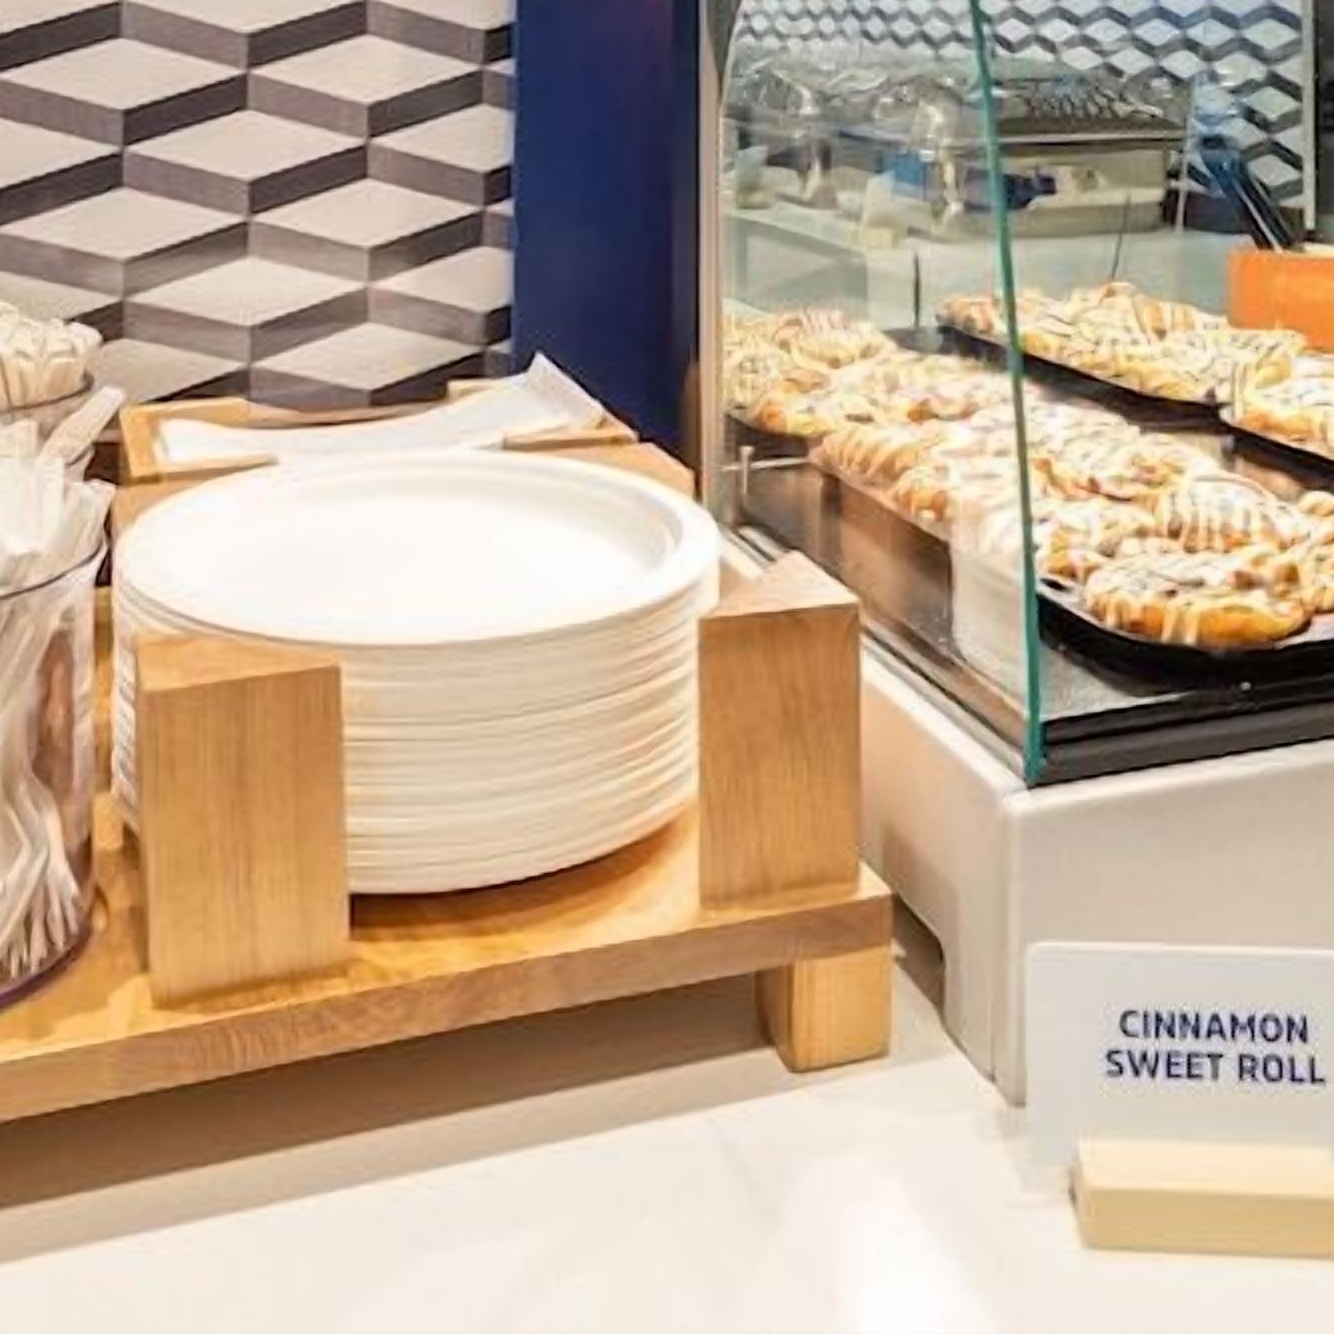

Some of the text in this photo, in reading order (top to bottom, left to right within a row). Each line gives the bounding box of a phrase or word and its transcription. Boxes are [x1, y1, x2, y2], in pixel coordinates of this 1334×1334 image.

[1118, 1009, 1309, 1045] CINNAMON
[1104, 1049, 1327, 1087] SWEET ROLL
